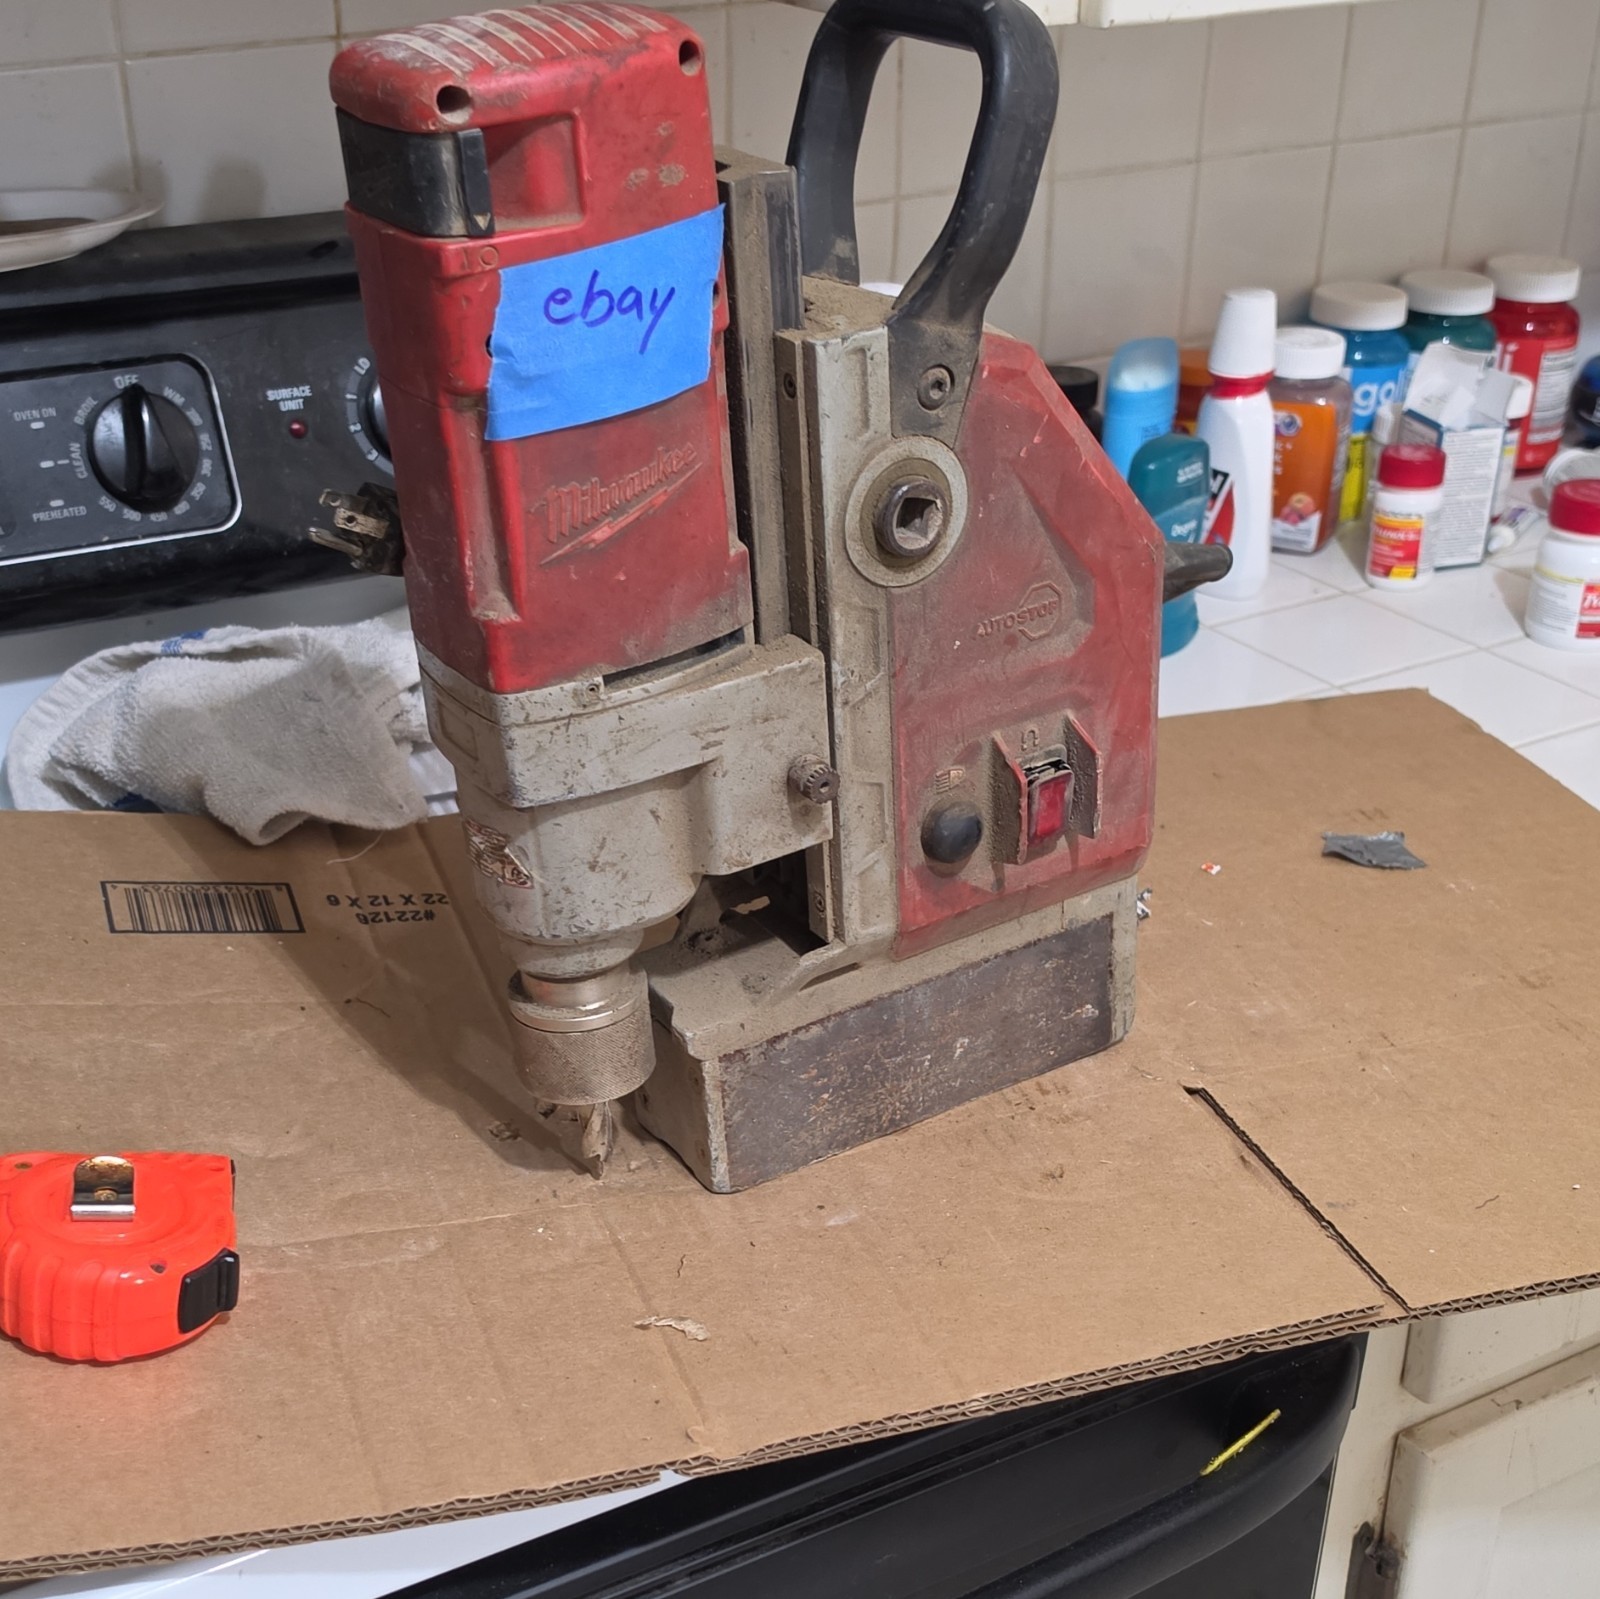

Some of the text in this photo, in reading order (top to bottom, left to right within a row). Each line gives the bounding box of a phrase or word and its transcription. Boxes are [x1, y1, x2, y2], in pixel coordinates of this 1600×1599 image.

[543, 269, 676, 355] ebay
[353, 357, 371, 375] LO
[163, 386, 186, 406] WM
[266, 385, 312, 401] SURFACE
[74, 396, 98, 425] BROIL
[279, 398, 304, 411] UNIT
[14, 407, 56, 422] OVEN ON
[69, 443, 88, 479] CLEAN
[529, 442, 698, 543] Milwaukee
[98, 496, 117, 512] 550
[32, 506, 87, 522] PREHEATED
[122, 508, 141, 521] 500
[975, 598, 1059, 637] AUTOSTOP
[326, 894, 341, 906] 6
[367, 894, 395, 906] 12
[421, 893, 449, 905] 22
[355, 910, 436, 925] #22126
